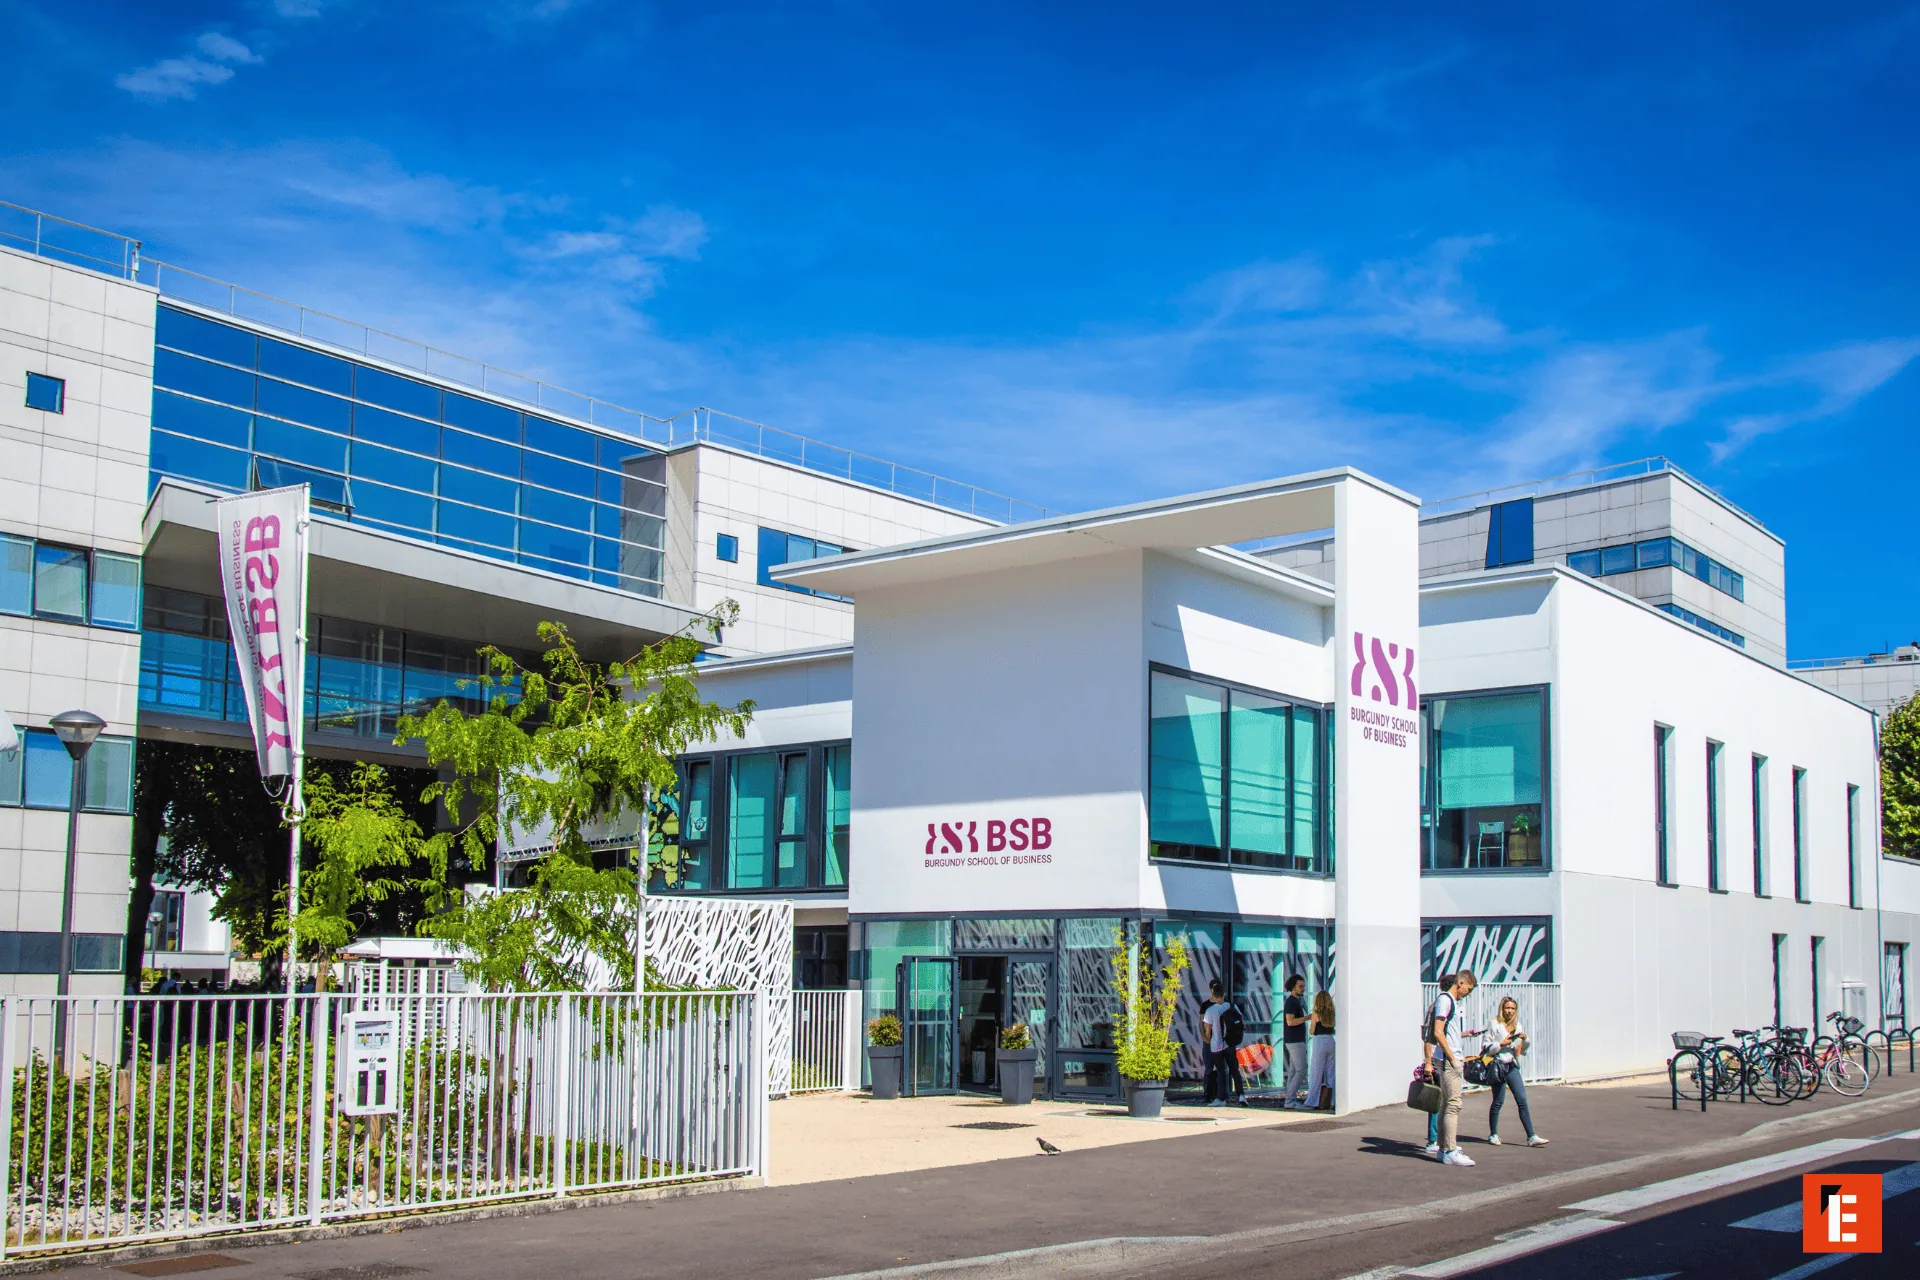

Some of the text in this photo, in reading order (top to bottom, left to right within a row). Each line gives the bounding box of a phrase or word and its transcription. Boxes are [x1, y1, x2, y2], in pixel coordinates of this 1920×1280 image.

[1351, 707, 1418, 735] BURGUNDY SCHOOL
[1363, 726, 1407, 748] OF BUSINESS
[987, 817, 1052, 852] BSB
[924, 854, 1052, 868] BURGUNDY SCHOOL OF BUSINESS
